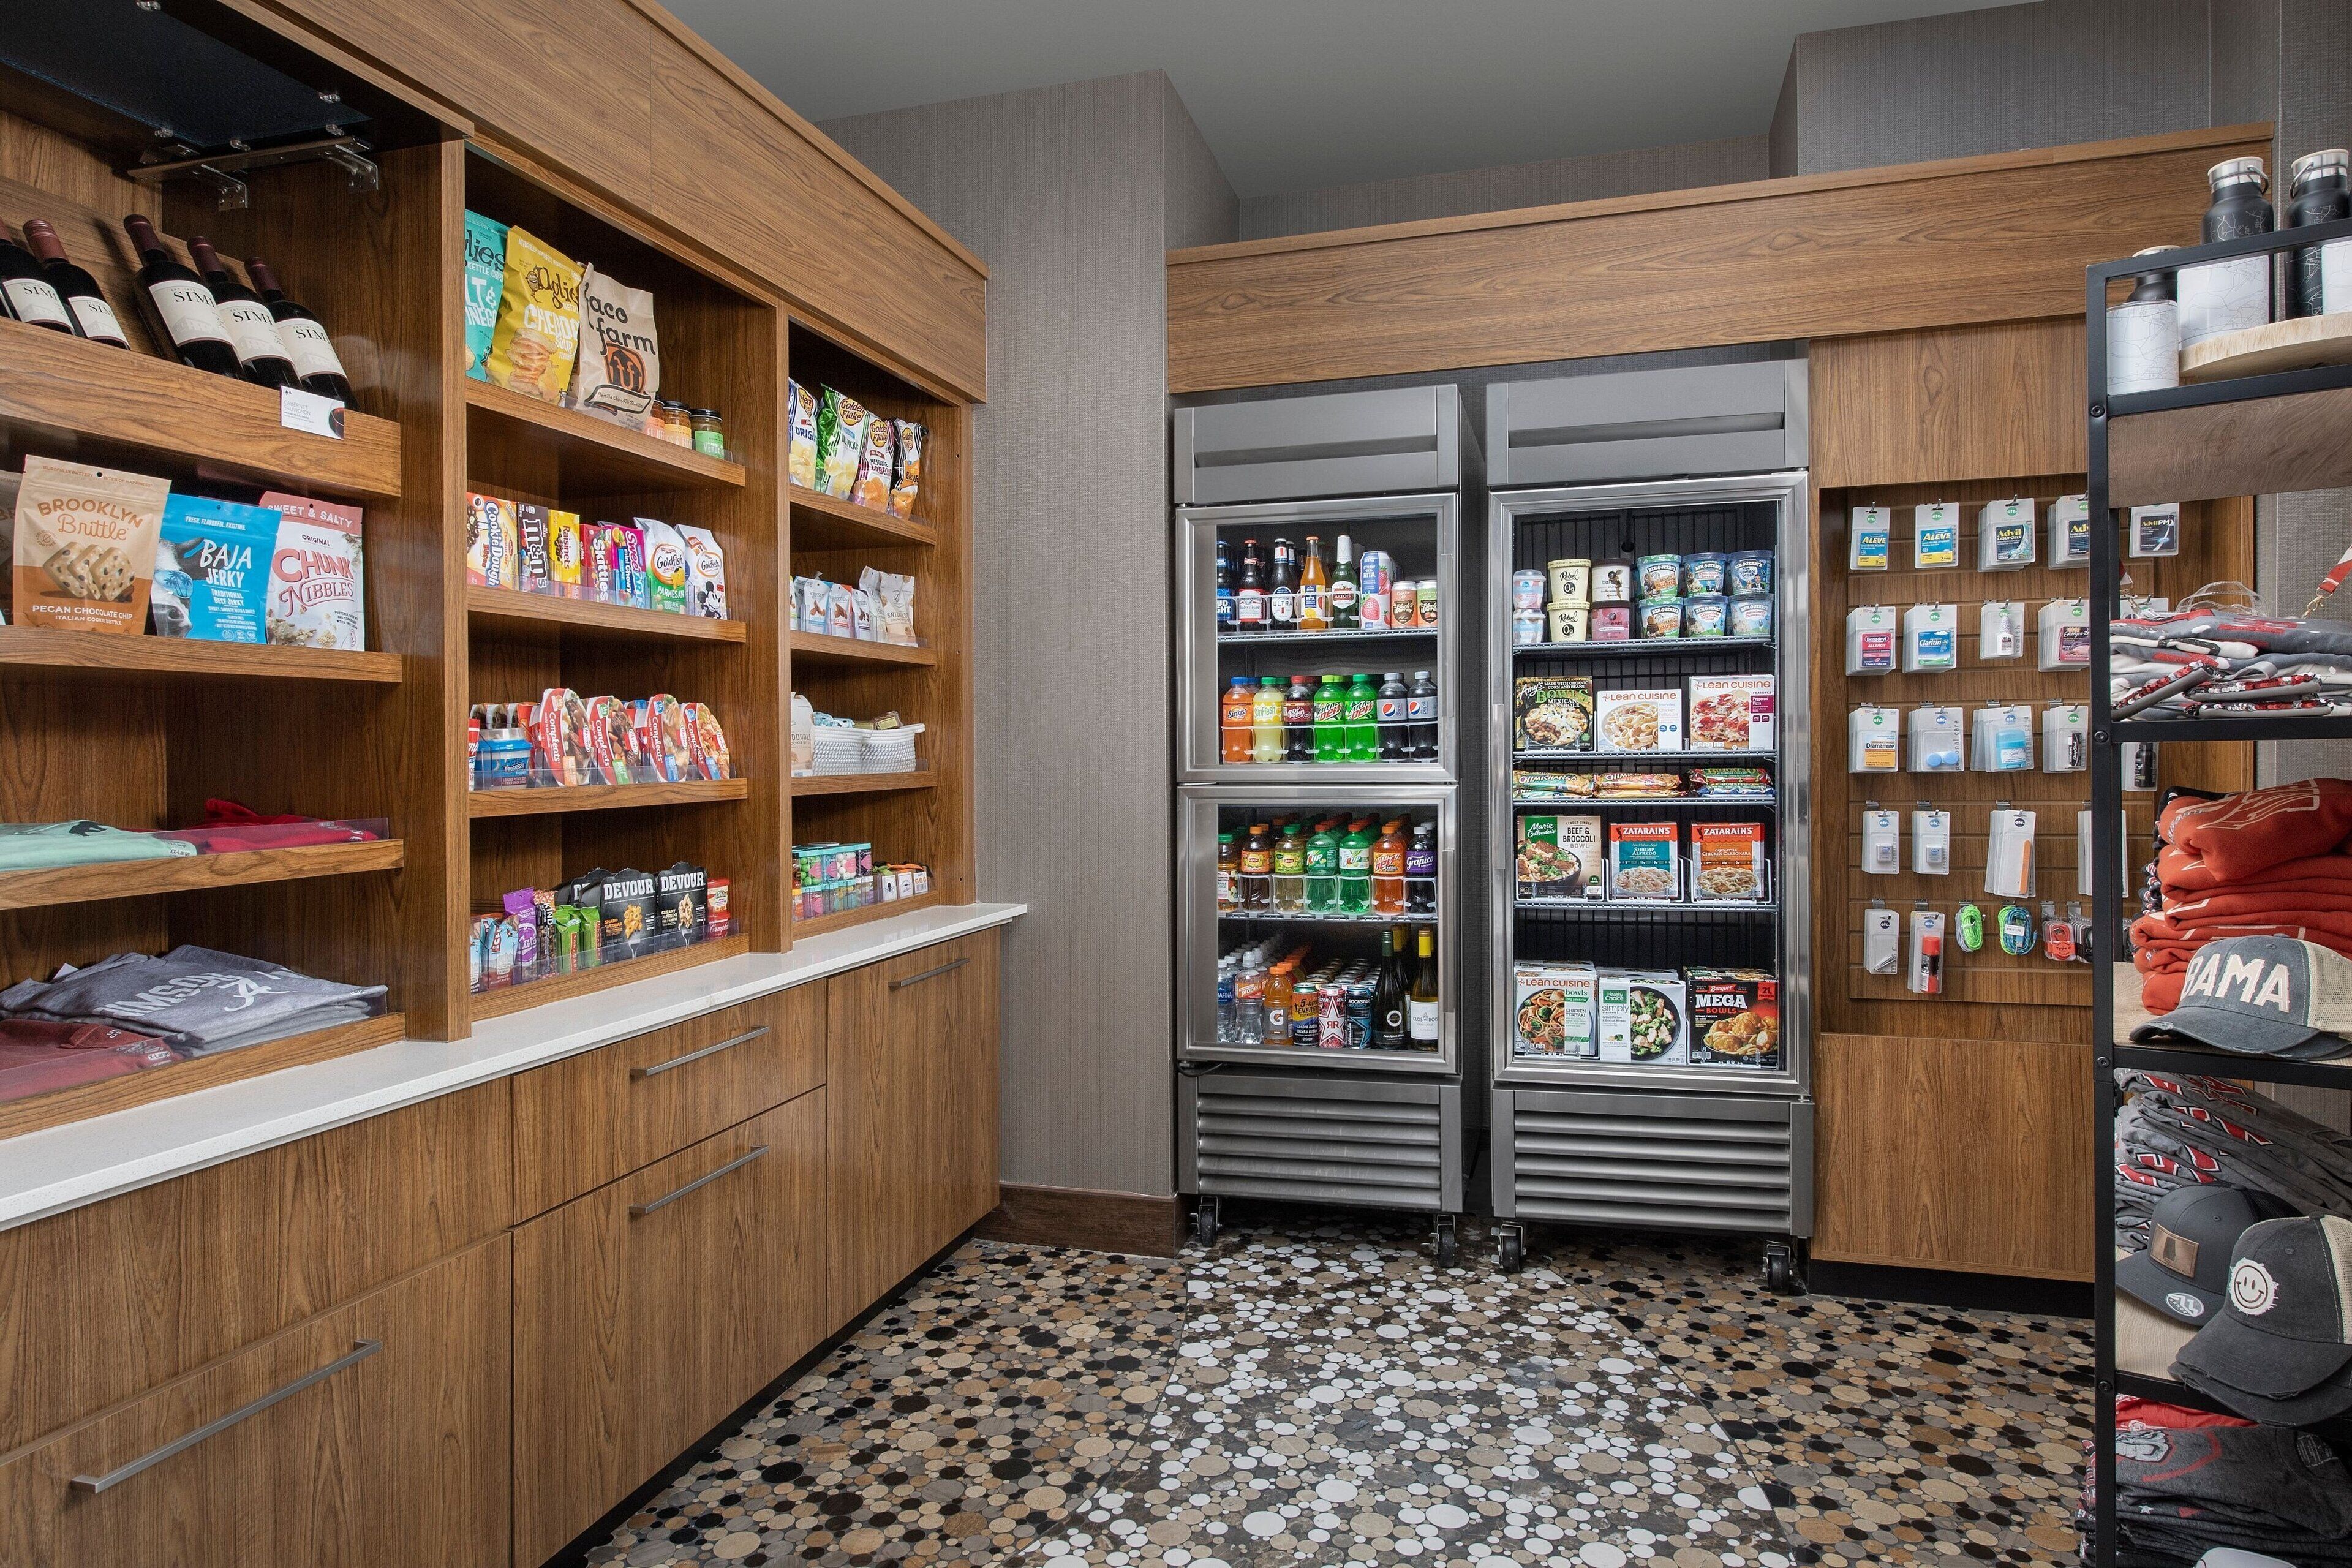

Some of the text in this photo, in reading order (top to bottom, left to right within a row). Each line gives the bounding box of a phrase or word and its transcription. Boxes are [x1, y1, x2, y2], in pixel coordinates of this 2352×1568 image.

[467, 263, 489, 275] KETTLE
[174, 291, 215, 307] SIMI
[233, 311, 273, 325] SIMI
[596, 317, 656, 355] farm
[841, 399, 865, 413] Golden
[842, 410, 861, 421] Flake
[38, 499, 143, 528] BROOKLYN
[307, 508, 353, 527] & SALTY
[58, 513, 127, 540] Brittle
[1997, 529, 2021, 537] Advil
[301, 534, 330, 546] ORIGINAL
[1923, 532, 1951, 541] ALEVE
[200, 538, 252, 570] BAJA
[657, 554, 683, 568] Goldfish
[272, 548, 354, 582] CHUNK
[593, 538, 608, 601] Skittles
[701, 560, 720, 570] Goldfish
[206, 568, 244, 589] JERKY
[1560, 569, 1579, 581] Rebel
[211, 589, 244, 599] TRADITIONAL
[658, 586, 684, 598] PARMESAN
[1564, 583, 1575, 593] 0g
[214, 596, 227, 605] BEEF
[278, 581, 354, 617] NIBBLES
[32, 605, 133, 620] PECAN CHOCOLATE CHIP
[1558, 611, 1578, 624] Rebel
[1563, 625, 1574, 635] 0g
[1520, 682, 1544, 699] Amy's
[1536, 689, 1588, 703] BOWLS
[1227, 709, 1247, 718] Sunkist
[549, 712, 560, 763] Compleats
[596, 720, 610, 767] Compleats
[652, 717, 663, 762] Compleats
[505, 763, 524, 772] PROGRESSO
[1519, 774, 1578, 784] CHIMICHANGA
[1407, 855, 1433, 870] Grapico
[660, 872, 706, 891] DEVOUR
[603, 878, 655, 900] DEVOUR
[2185, 954, 2290, 1014] BAMA
[1695, 994, 1747, 1009] MEGA
[1602, 1004, 1629, 1014] simply
